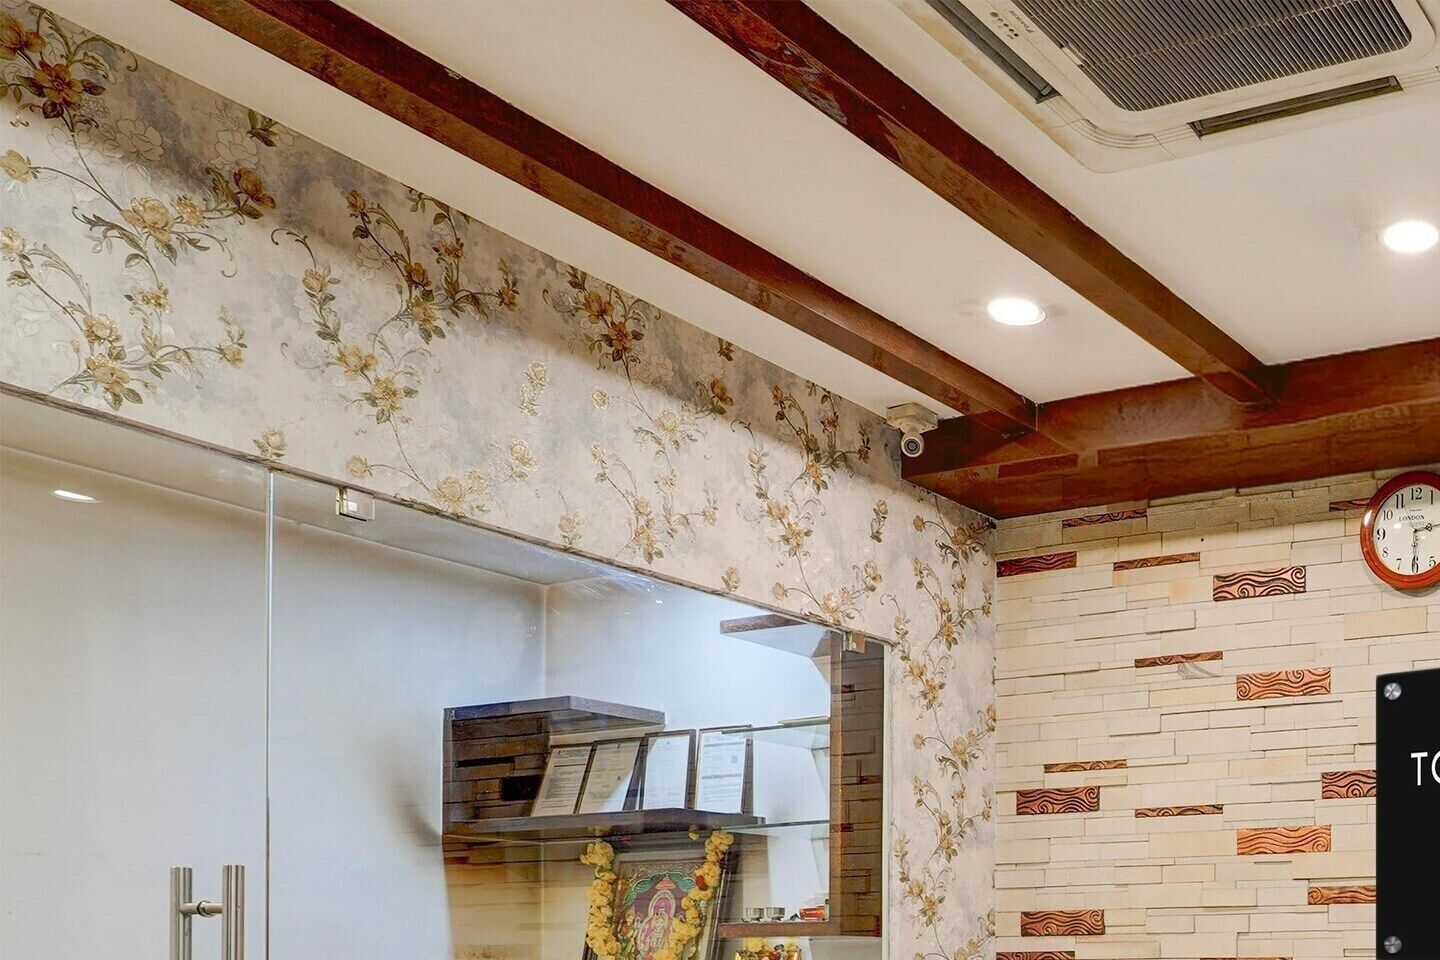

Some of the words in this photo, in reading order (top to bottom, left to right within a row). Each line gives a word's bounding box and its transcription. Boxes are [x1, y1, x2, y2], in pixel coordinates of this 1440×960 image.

[1410, 487, 1422, 500] 12
[1430, 490, 1434, 505] 1
[1395, 493, 1404, 509] 11
[1383, 510, 1393, 521] 10
[1377, 527, 1386, 540] 9
[1382, 546, 1389, 558] 8
[1396, 558, 1402, 570] 7
[1411, 555, 1419, 573] 6
[1429, 556, 1436, 567] 5
